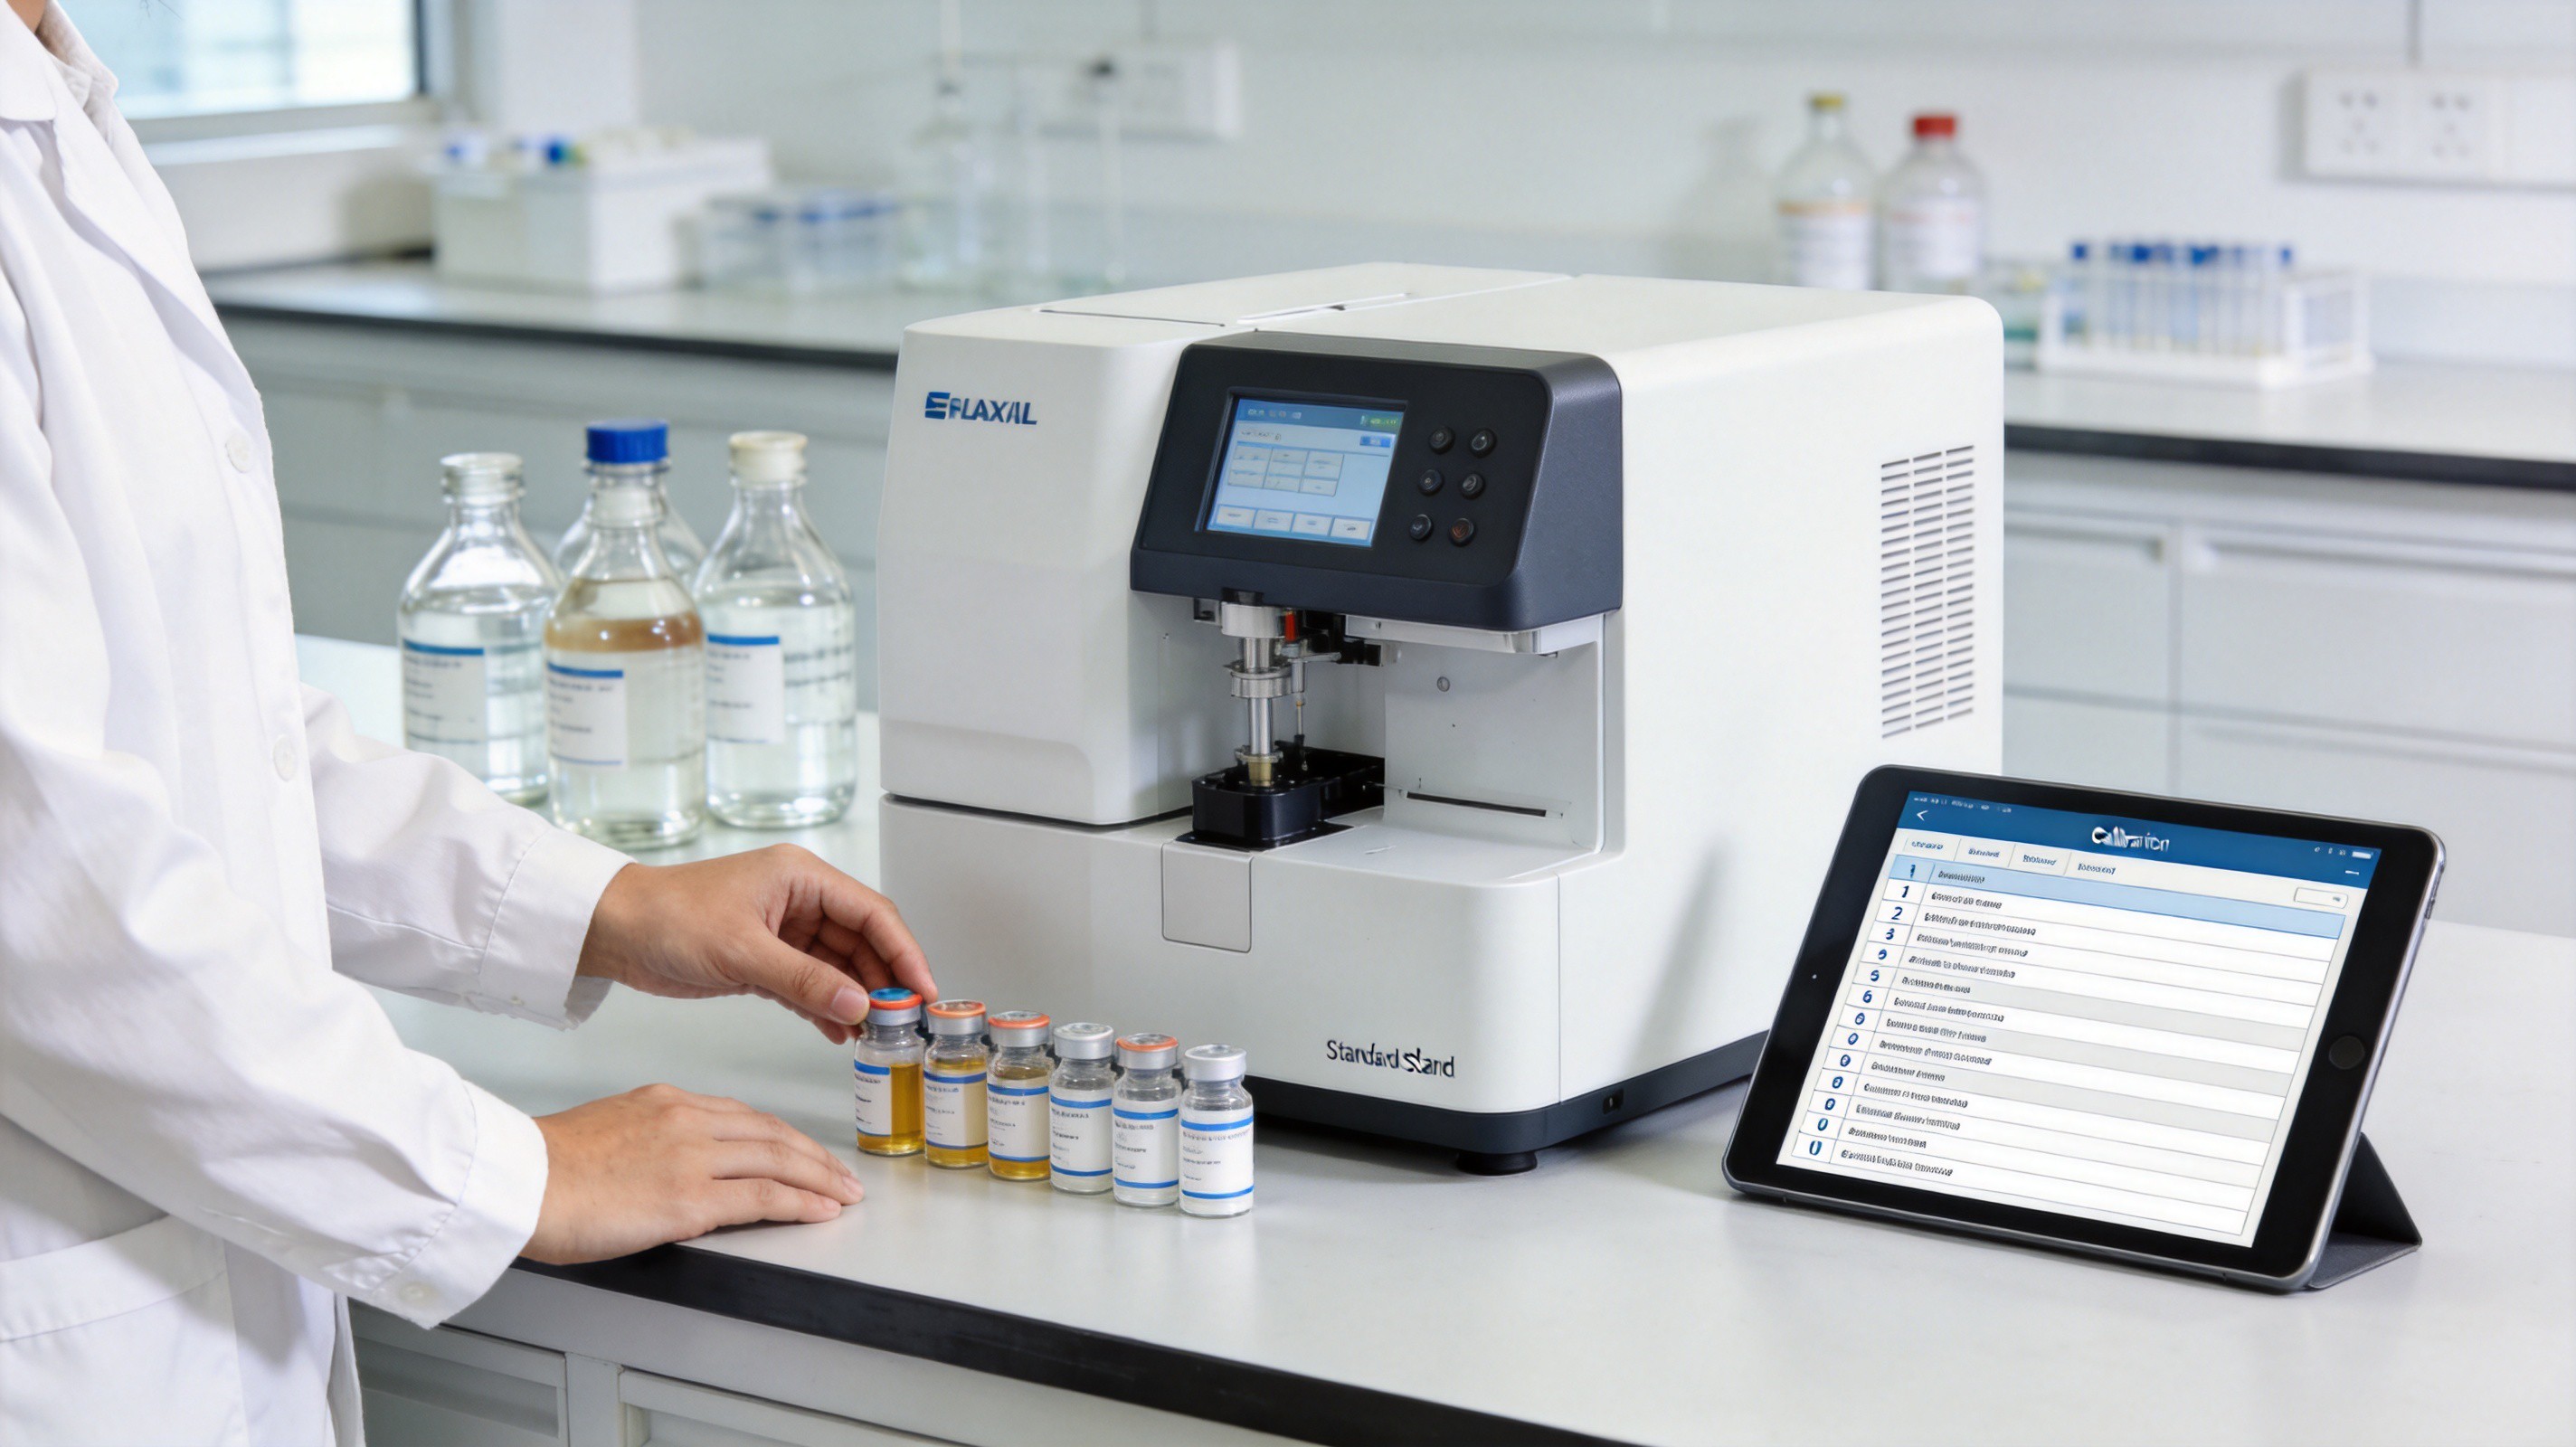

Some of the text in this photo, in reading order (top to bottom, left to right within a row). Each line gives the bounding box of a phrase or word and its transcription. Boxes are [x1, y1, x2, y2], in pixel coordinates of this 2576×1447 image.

[1901, 885, 1909, 898] 1
[1890, 906, 1903, 921] 2
[1885, 928, 1895, 941] 3
[1862, 989, 1872, 1004] 6
